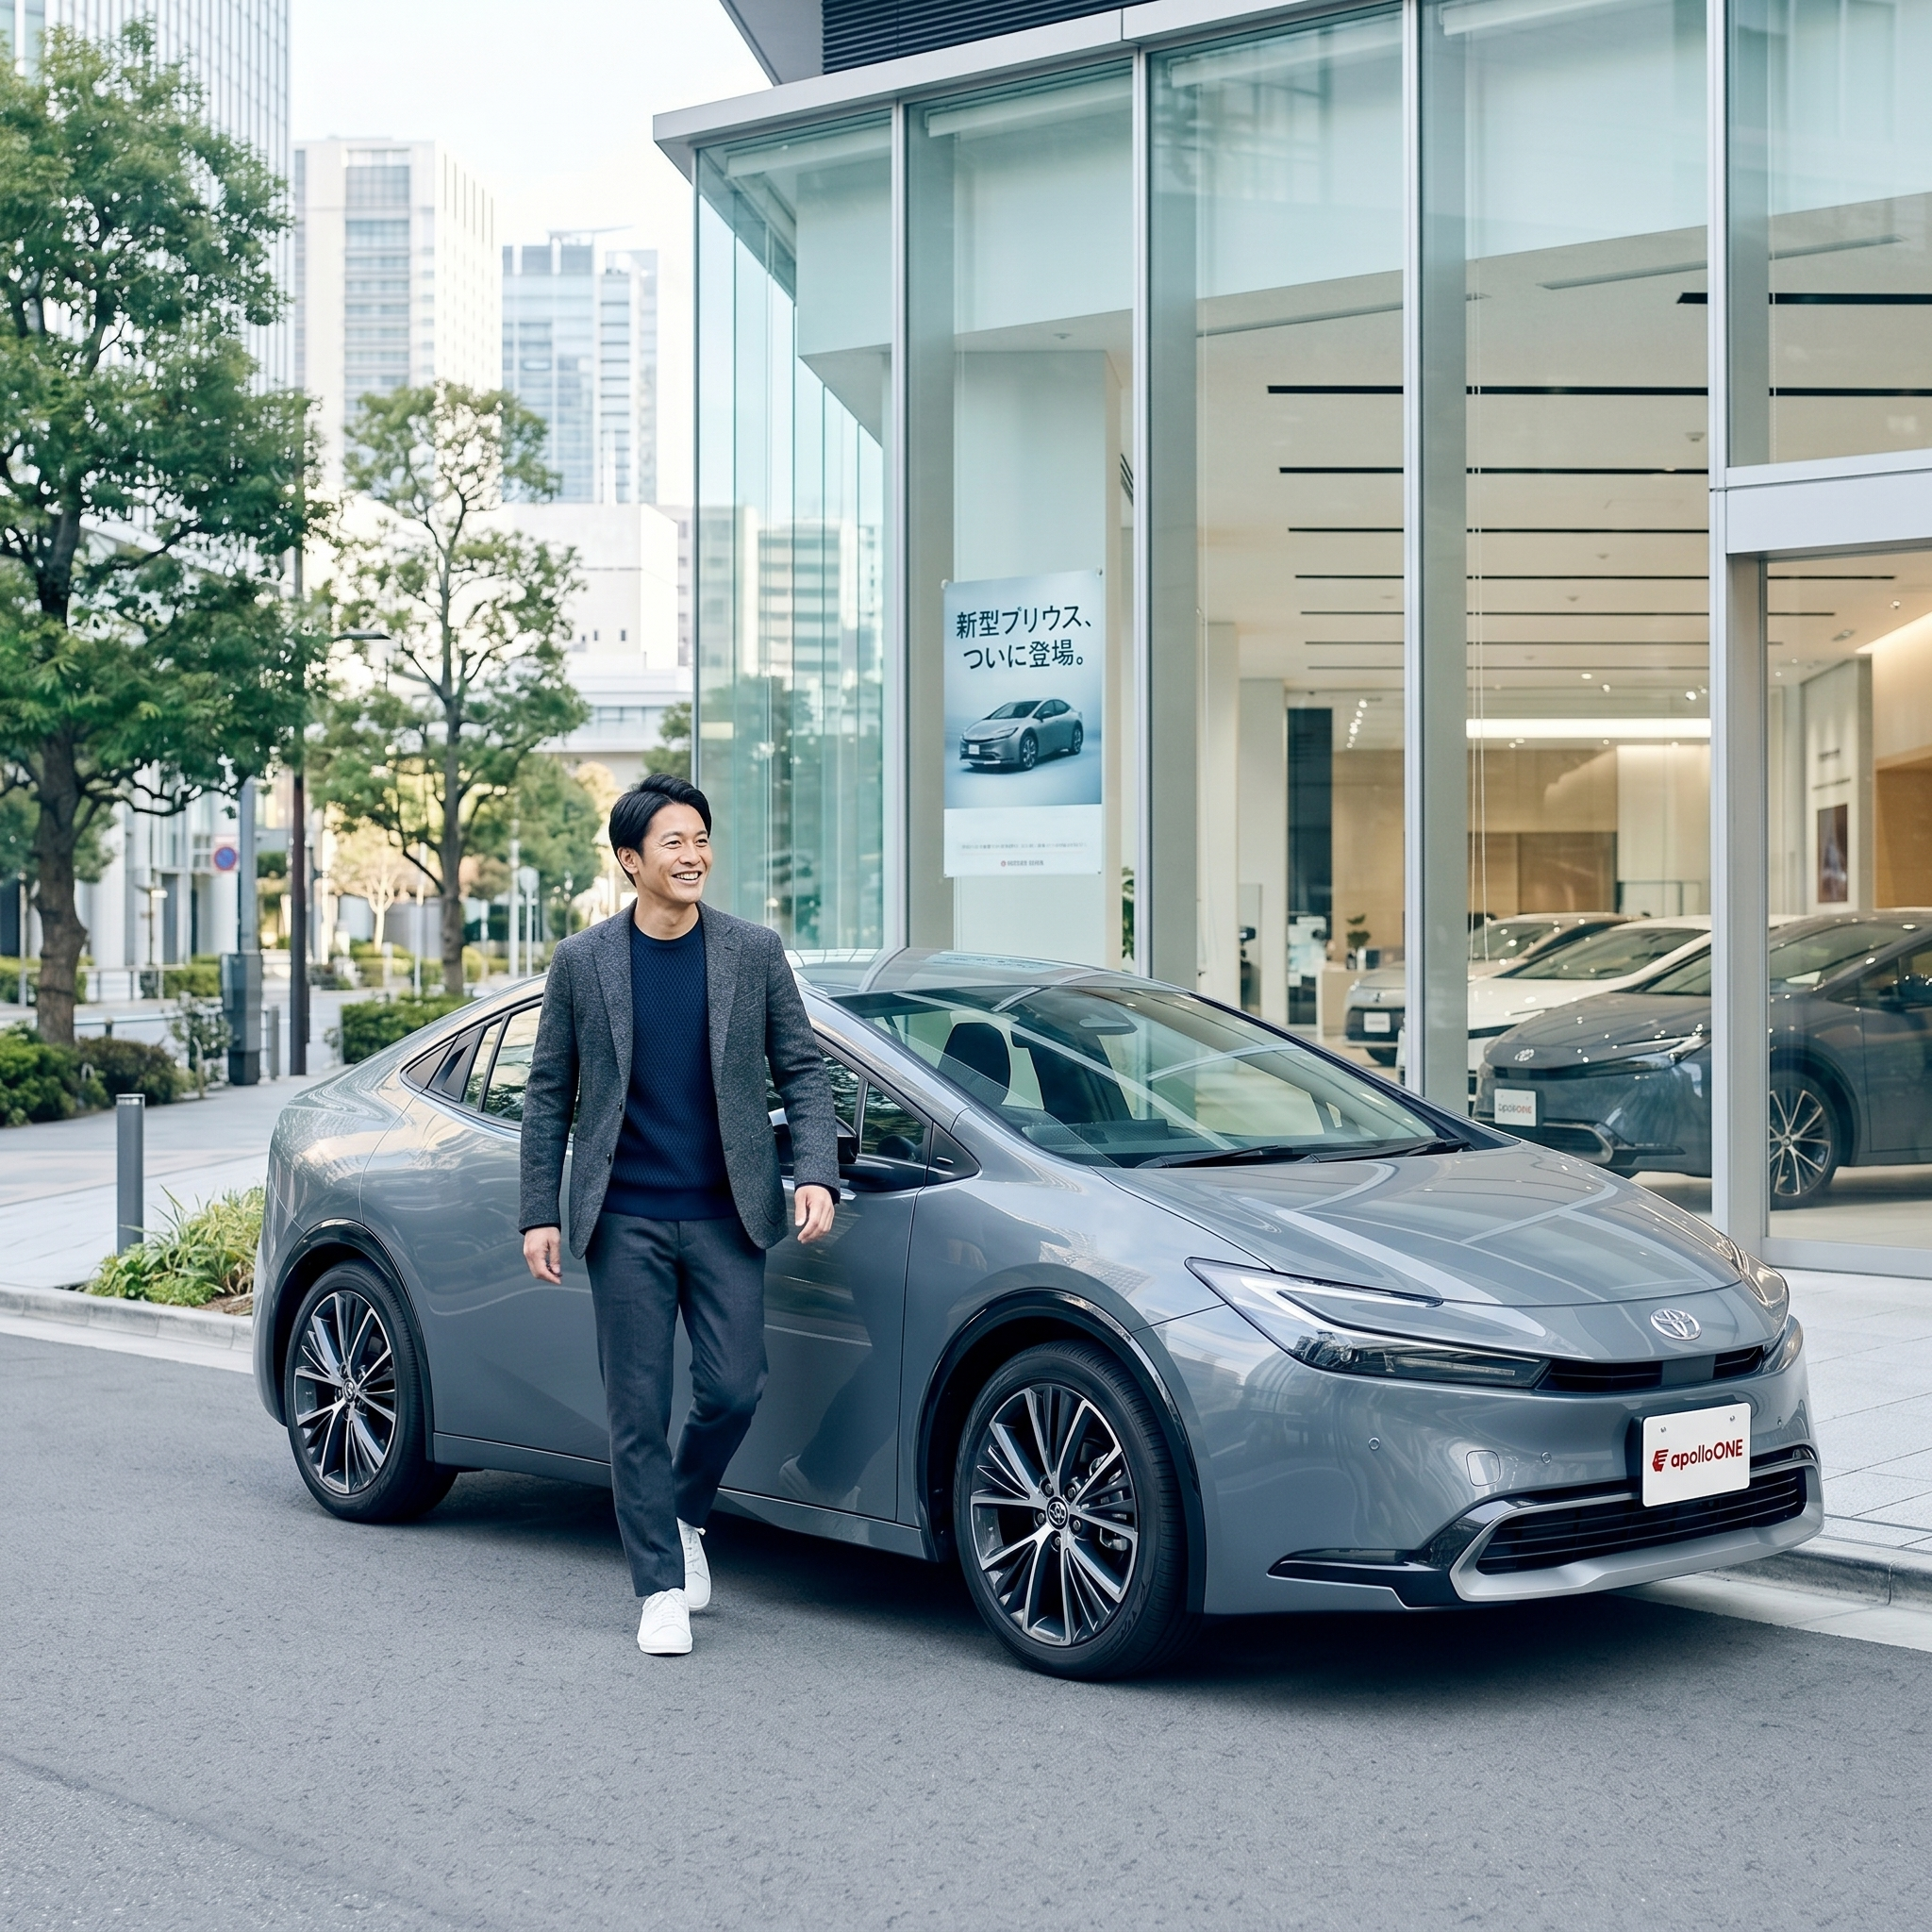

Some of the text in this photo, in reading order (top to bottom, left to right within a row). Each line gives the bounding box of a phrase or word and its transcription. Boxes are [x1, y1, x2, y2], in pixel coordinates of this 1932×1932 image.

[957, 605, 1091, 639] 新型プリウス、
[963, 639, 1084, 670] ついに登場。
[1671, 1439, 1743, 1471] apolloONE
